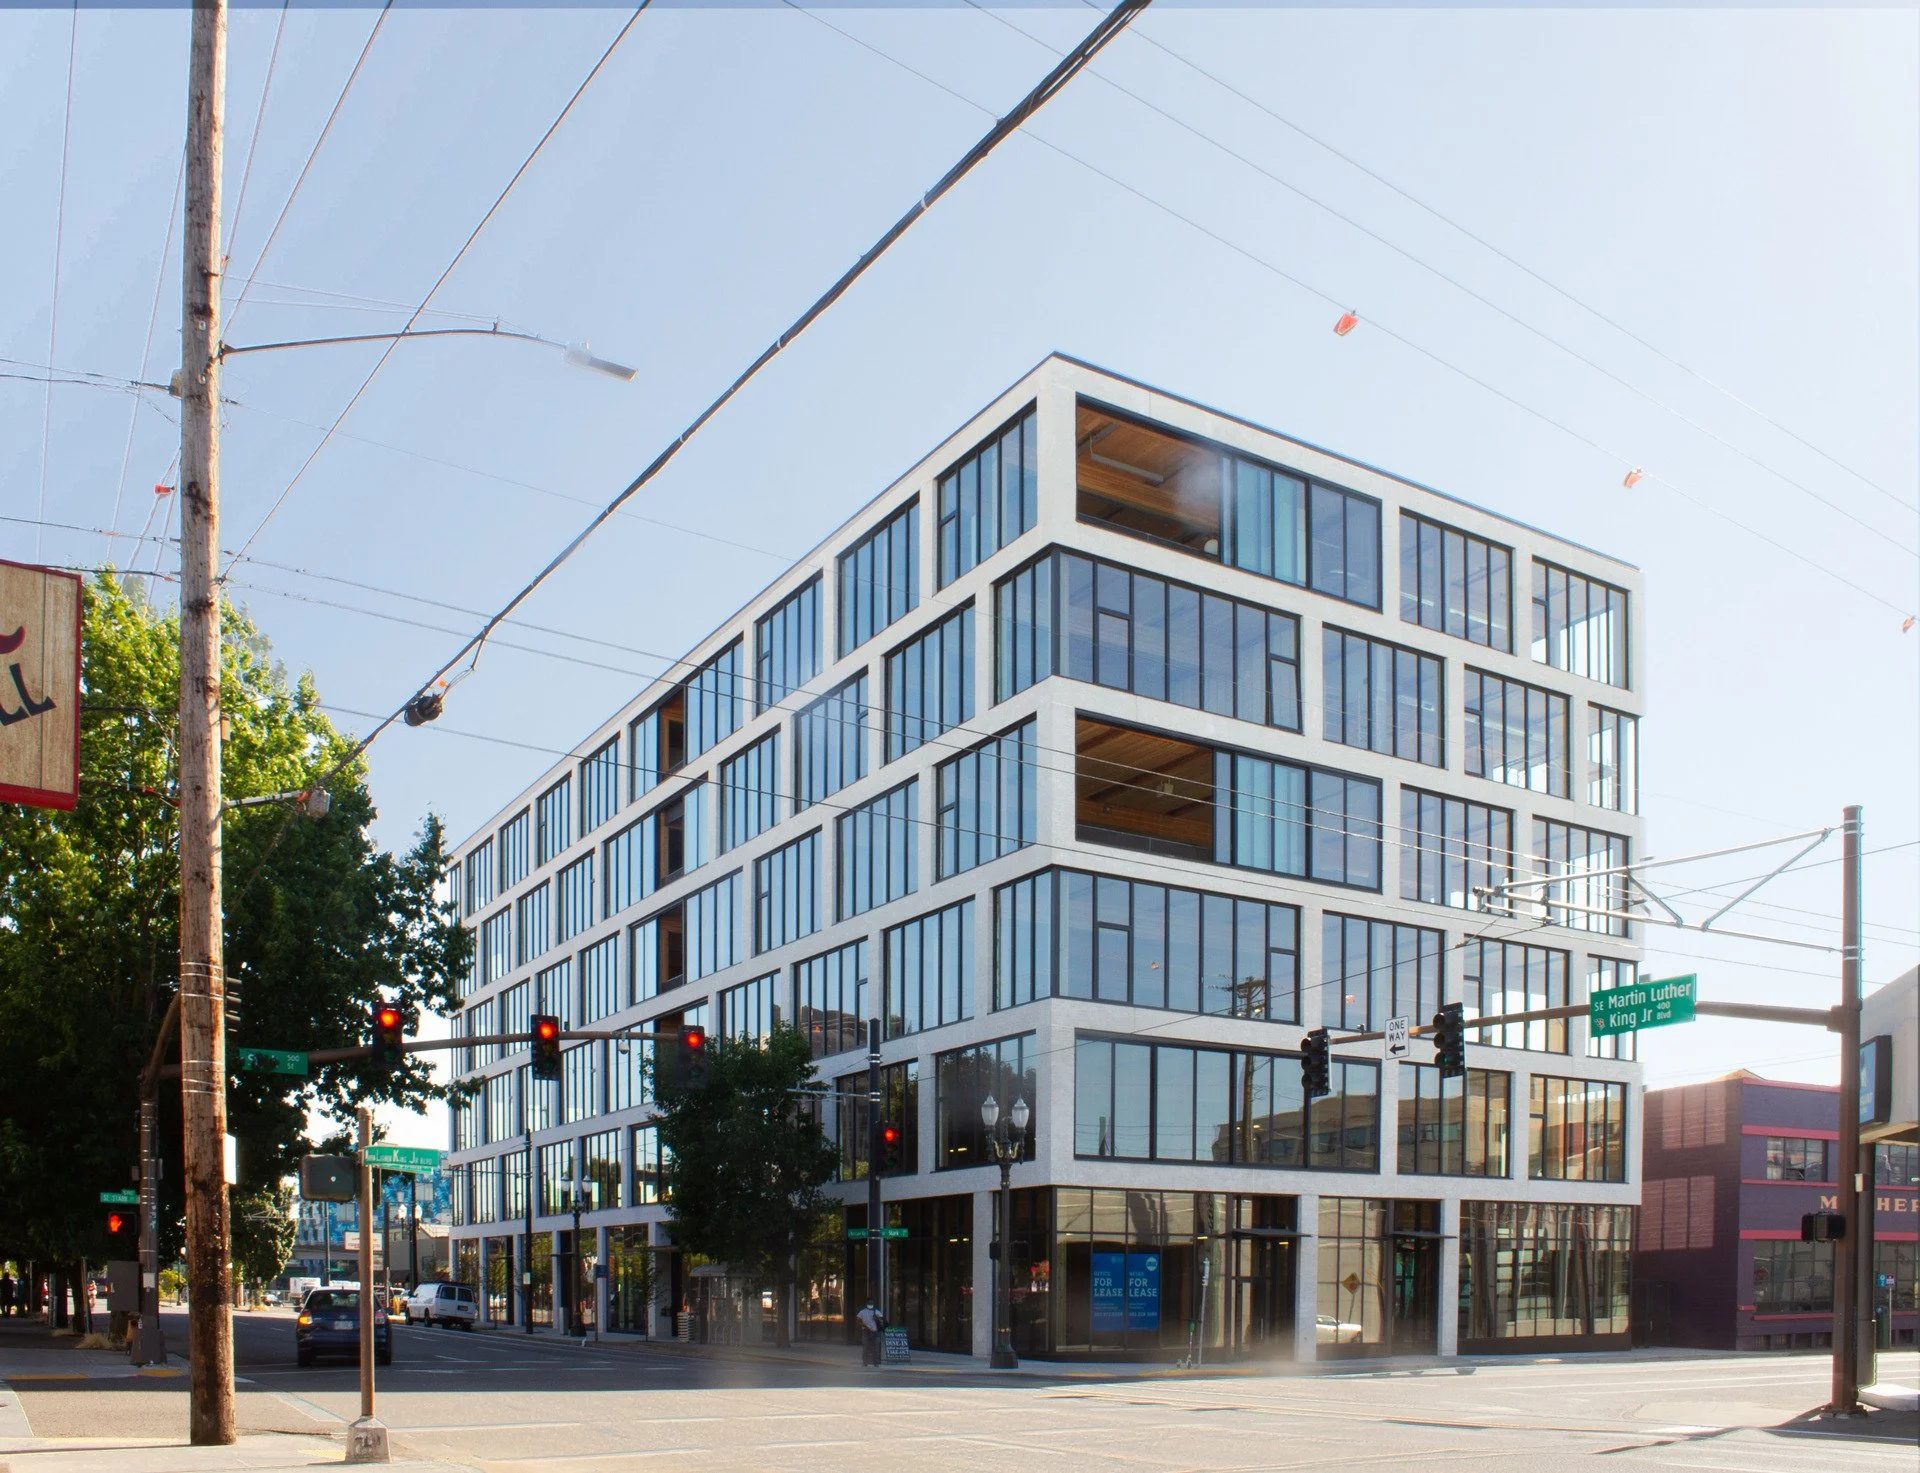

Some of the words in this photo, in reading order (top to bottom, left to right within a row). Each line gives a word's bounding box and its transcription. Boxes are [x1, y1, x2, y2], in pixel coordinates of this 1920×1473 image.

[1594, 1001, 1604, 1012] SE
[1608, 989, 1646, 1009] Martin
[1650, 983, 1691, 1002] Luther
[1656, 1001, 1671, 1010] 400
[1609, 1011, 1637, 1028] King
[1641, 1008, 1653, 1023] Jr
[1656, 1010, 1672, 1020] Blvd
[1389, 1020, 1405, 1031] ONE
[1389, 1031, 1405, 1042] WAY
[1093, 1277, 1113, 1287] FOR
[1128, 1277, 1149, 1287] FOR
[1093, 1287, 1124, 1297] LEASE
[1128, 1287, 1158, 1297] LEASE
